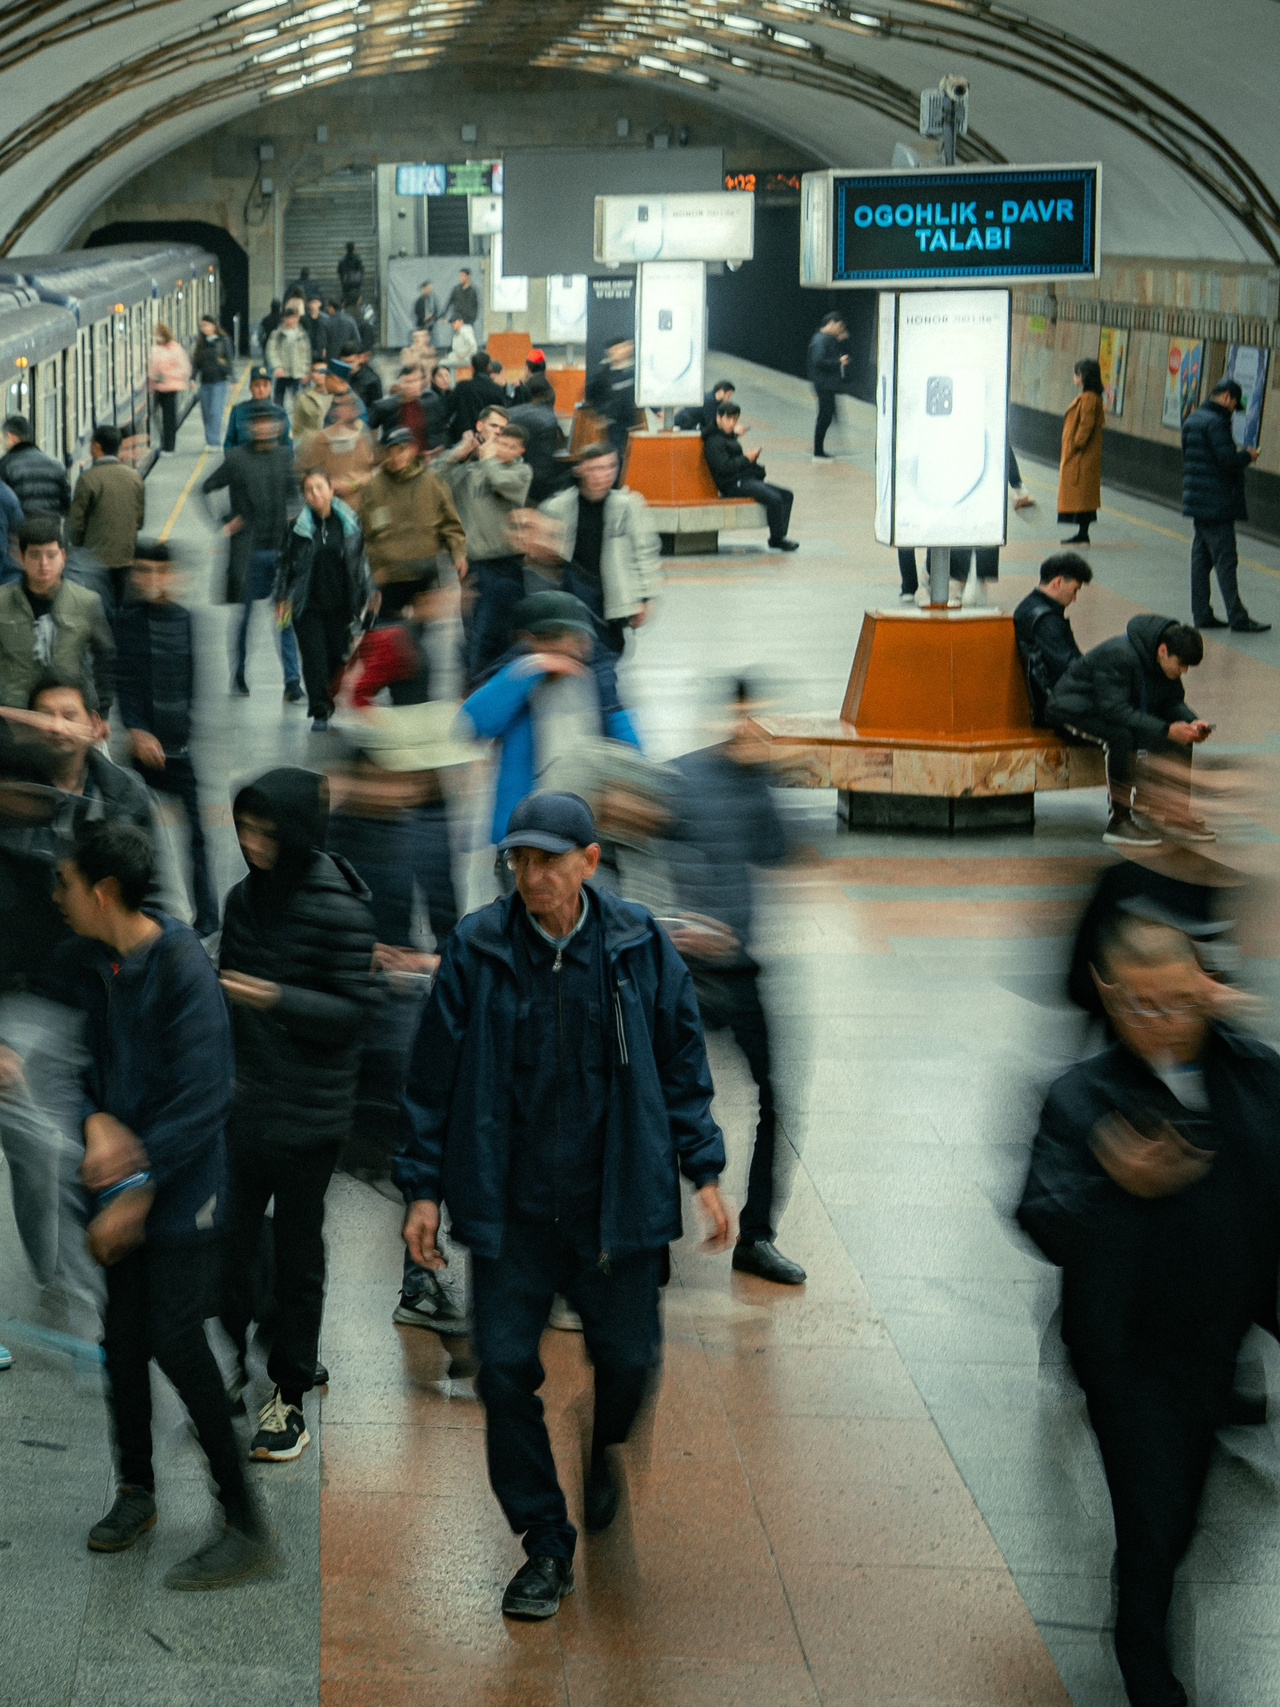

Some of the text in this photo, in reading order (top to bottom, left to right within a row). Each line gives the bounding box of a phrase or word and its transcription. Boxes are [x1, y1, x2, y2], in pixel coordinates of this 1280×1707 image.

[853, 201, 978, 228] OGOHLIK
[1001, 198, 1074, 224] DAVR
[915, 225, 1011, 252] TALABI
